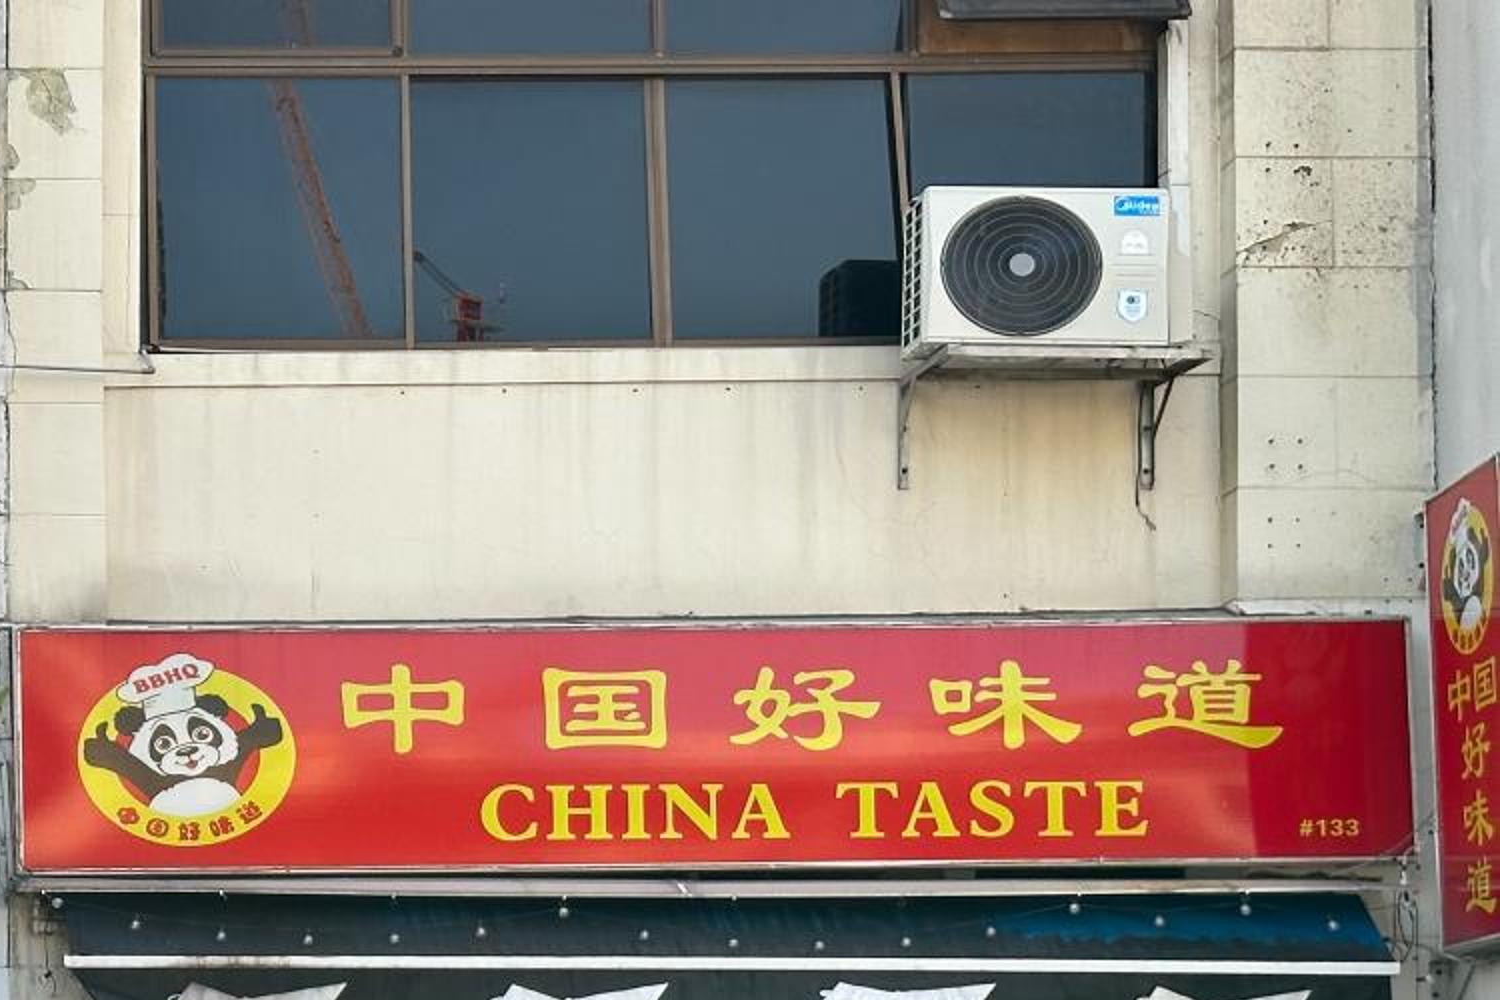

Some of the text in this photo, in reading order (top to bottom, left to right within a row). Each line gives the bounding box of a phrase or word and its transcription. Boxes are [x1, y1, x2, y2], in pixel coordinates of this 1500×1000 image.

[133, 663, 200, 694] BBHQ
[341, 660, 1284, 753] 中国好味道
[479, 779, 1151, 841] CHINA TASTE
[1447, 656, 1500, 914] 中国好味道
[1299, 817, 1360, 837] #133
